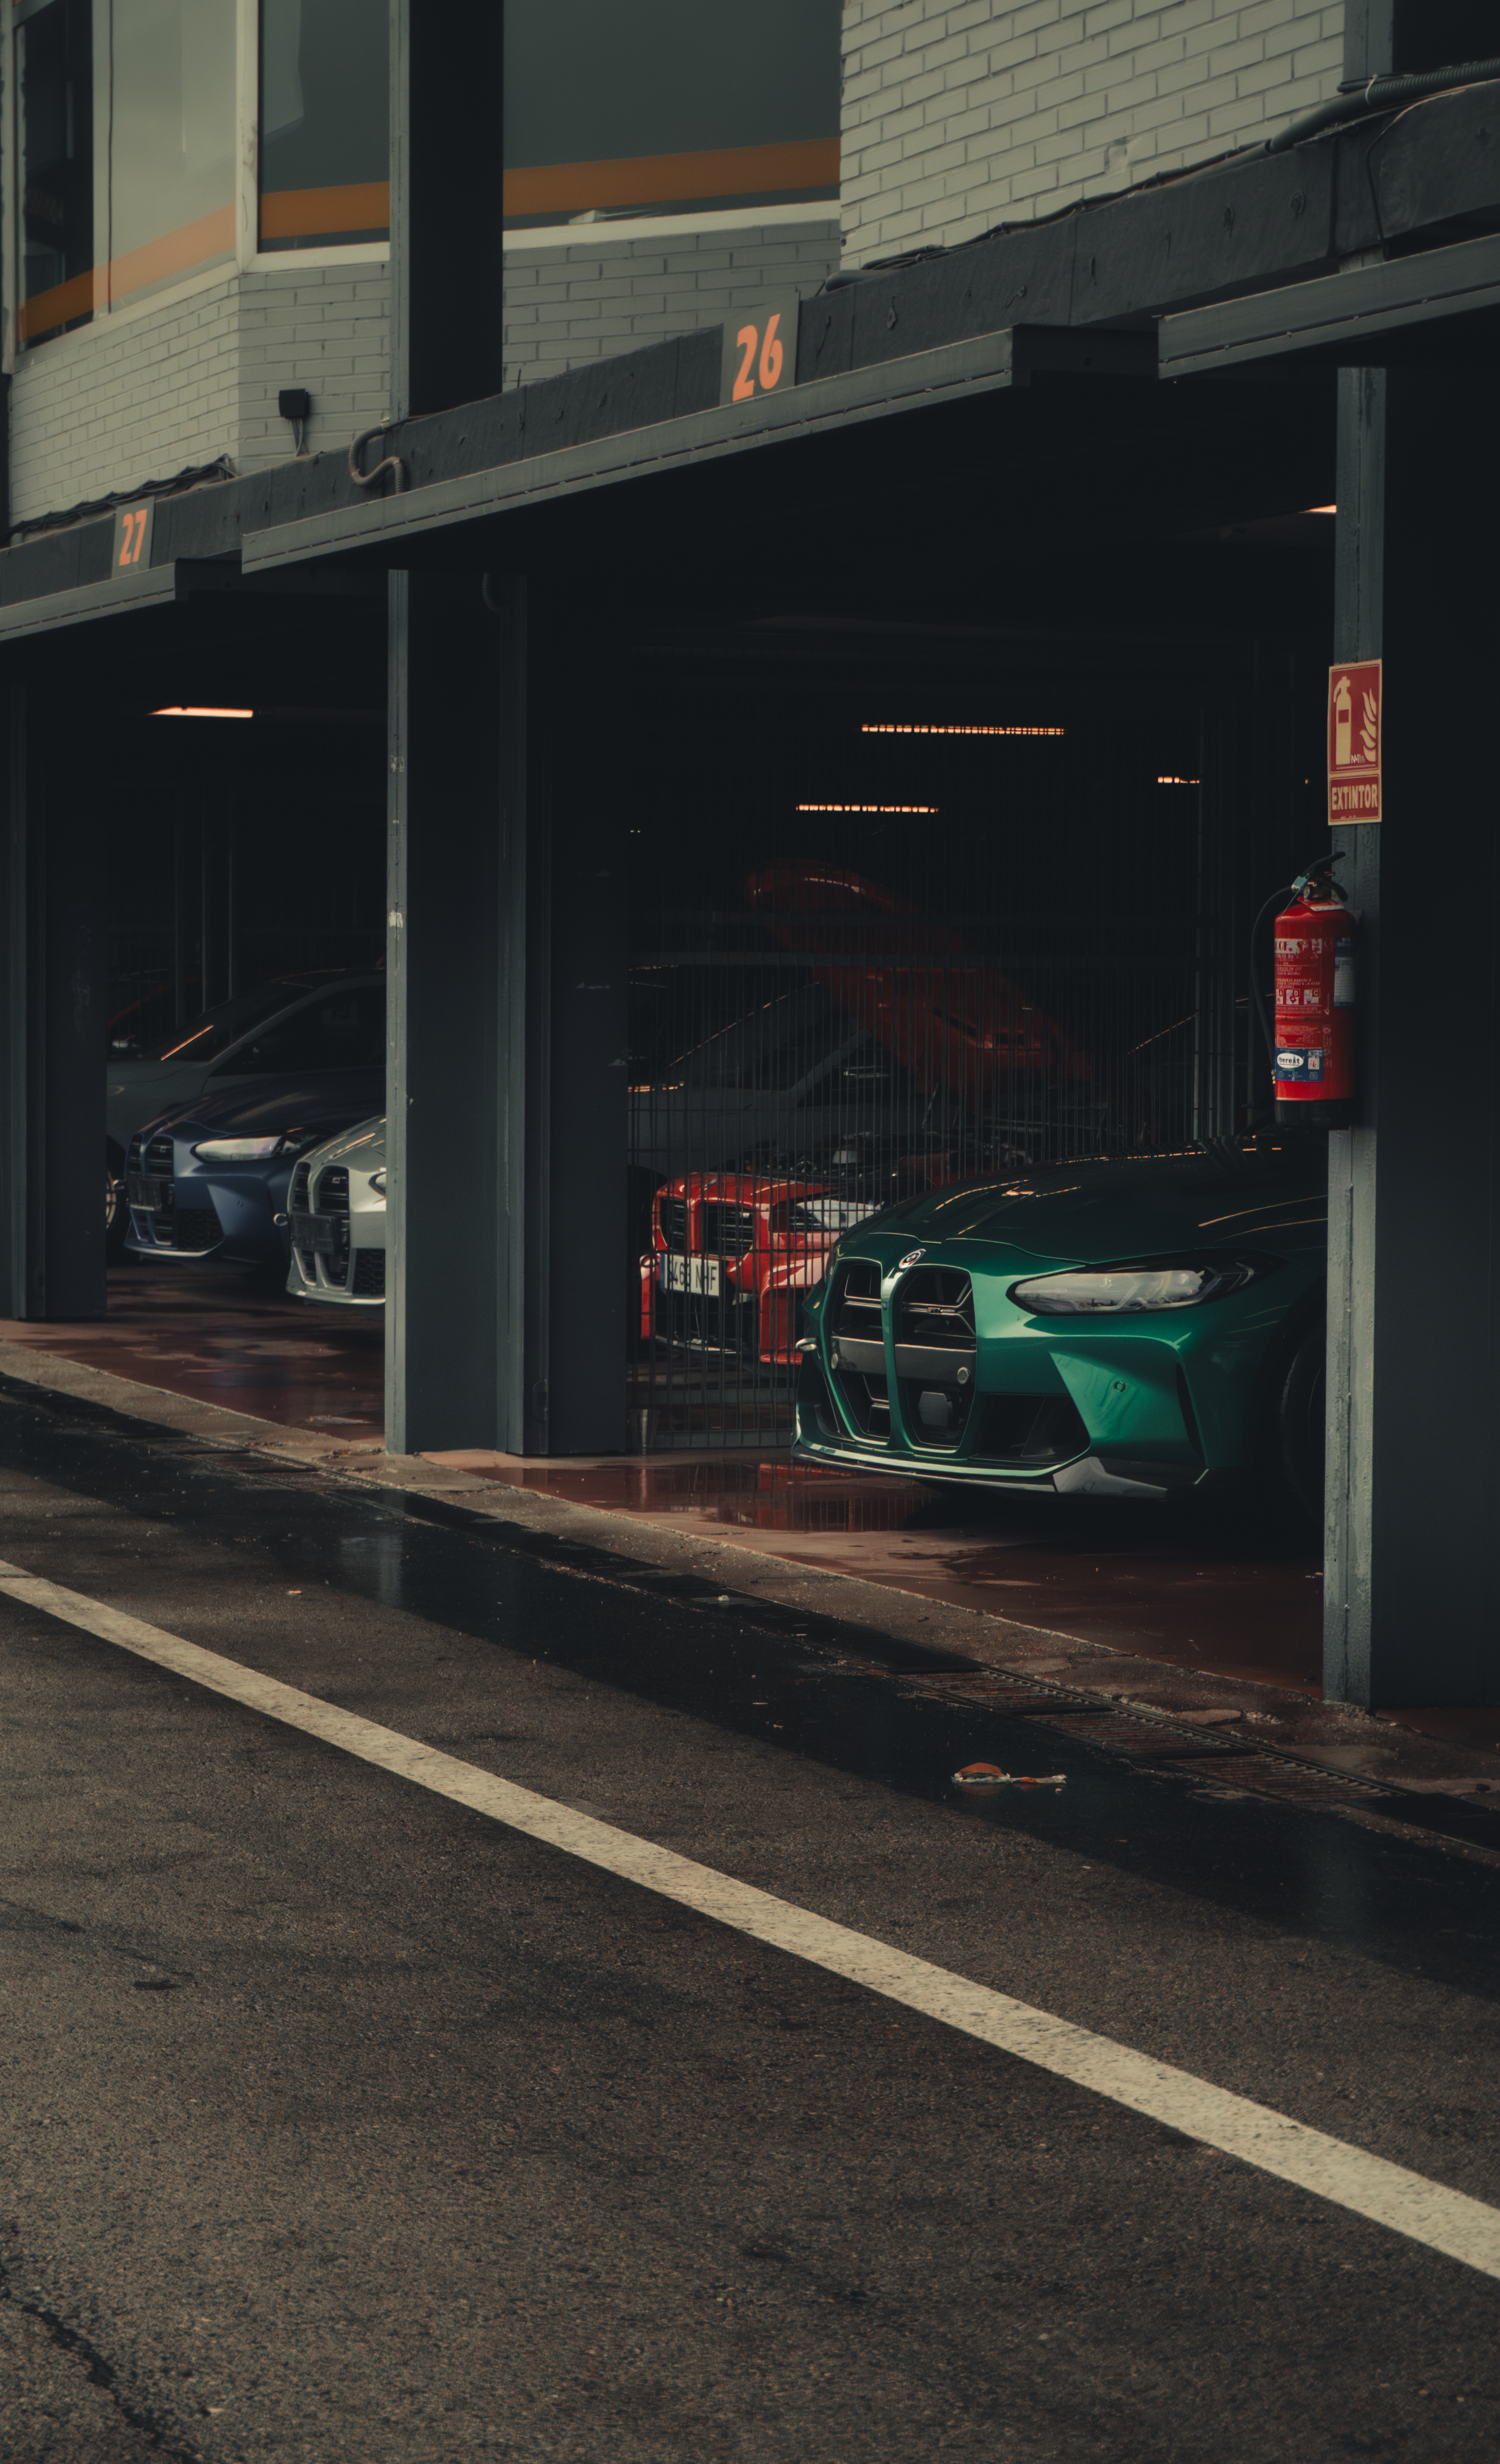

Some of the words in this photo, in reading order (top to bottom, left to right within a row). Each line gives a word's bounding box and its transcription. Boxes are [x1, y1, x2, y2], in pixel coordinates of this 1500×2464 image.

[732, 313, 783, 402] 26
[118, 509, 147, 566] 27
[1332, 784, 1378, 810] EXTINTOR
